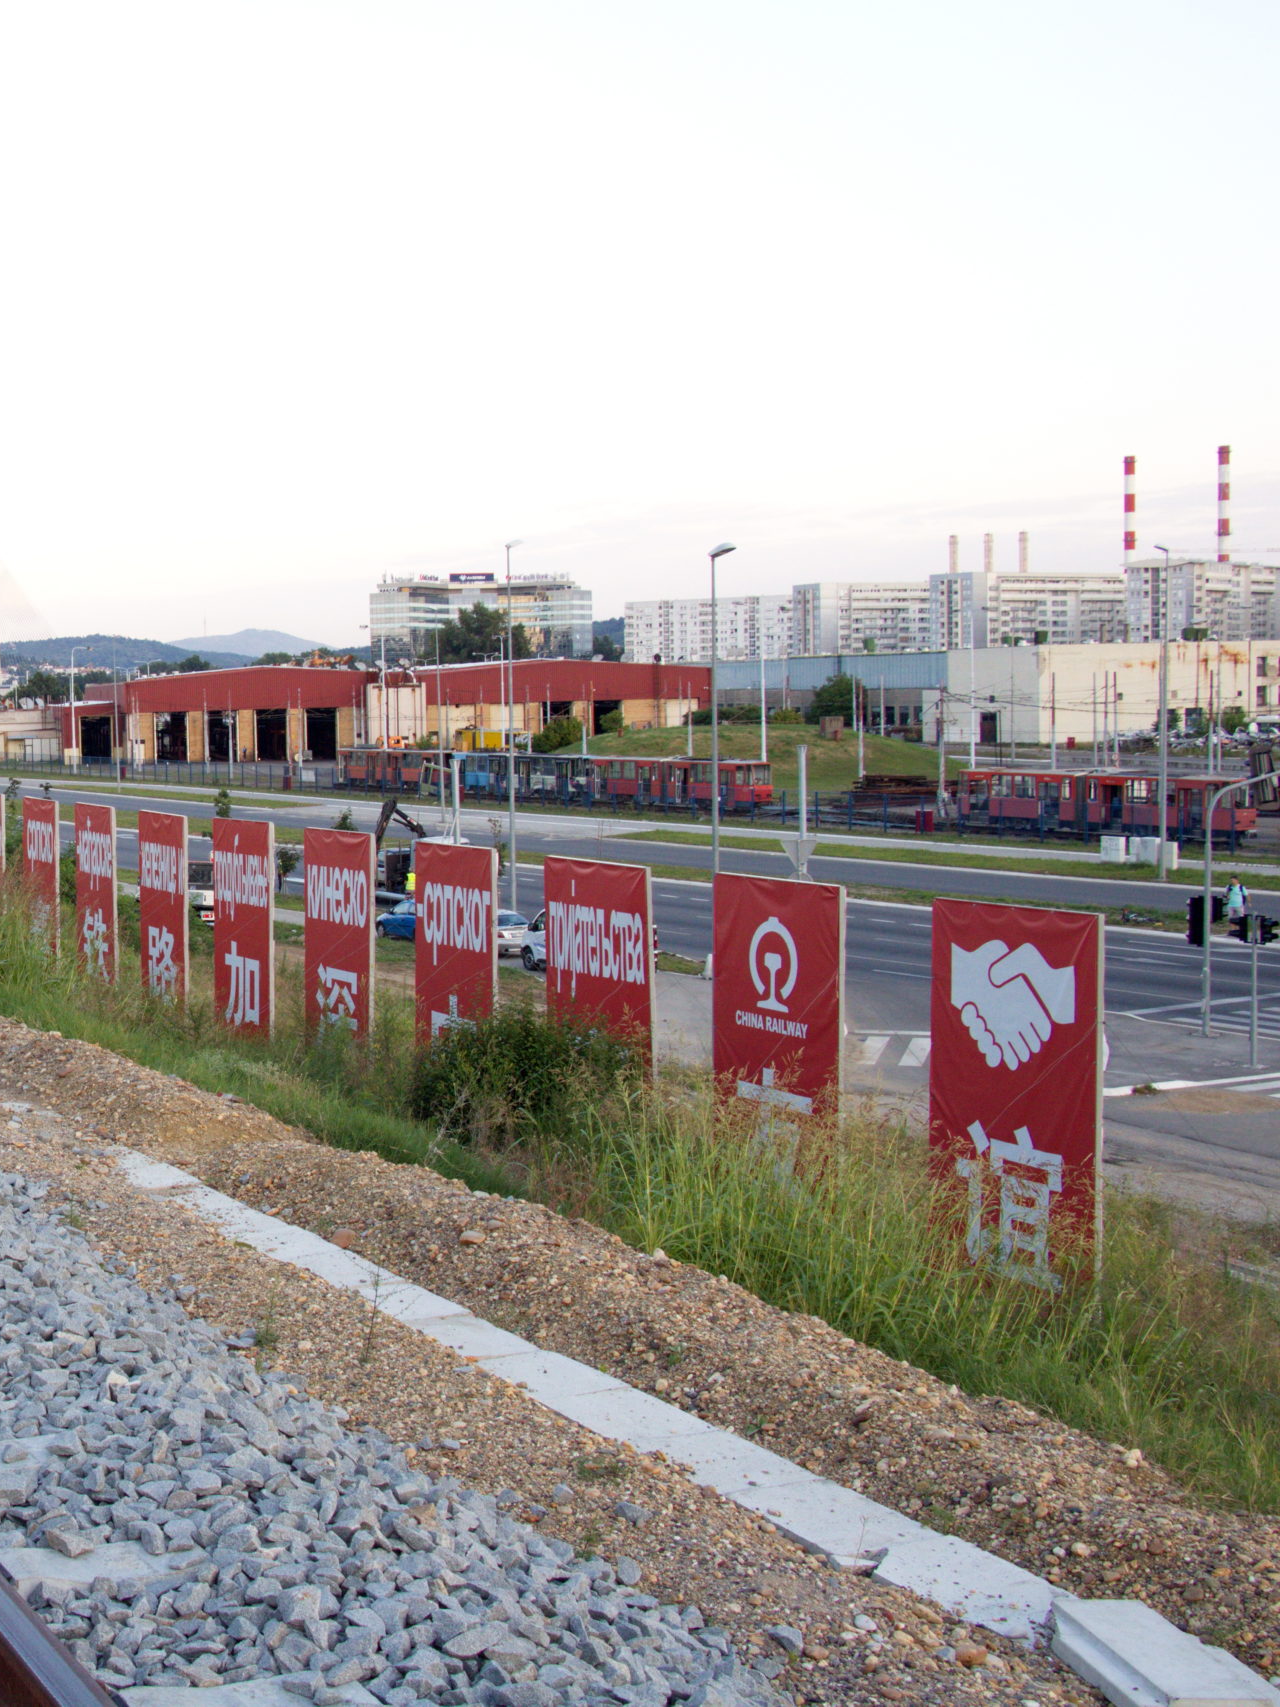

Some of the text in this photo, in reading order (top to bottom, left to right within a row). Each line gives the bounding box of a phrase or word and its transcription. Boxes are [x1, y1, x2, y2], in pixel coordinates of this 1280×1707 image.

[307, 864, 368, 929] кинеско
[416, 881, 491, 966] -српског
[549, 879, 646, 999] пријатељства
[225, 940, 260, 1026] 加
[735, 1009, 809, 1040] CHINA RAILWAY
